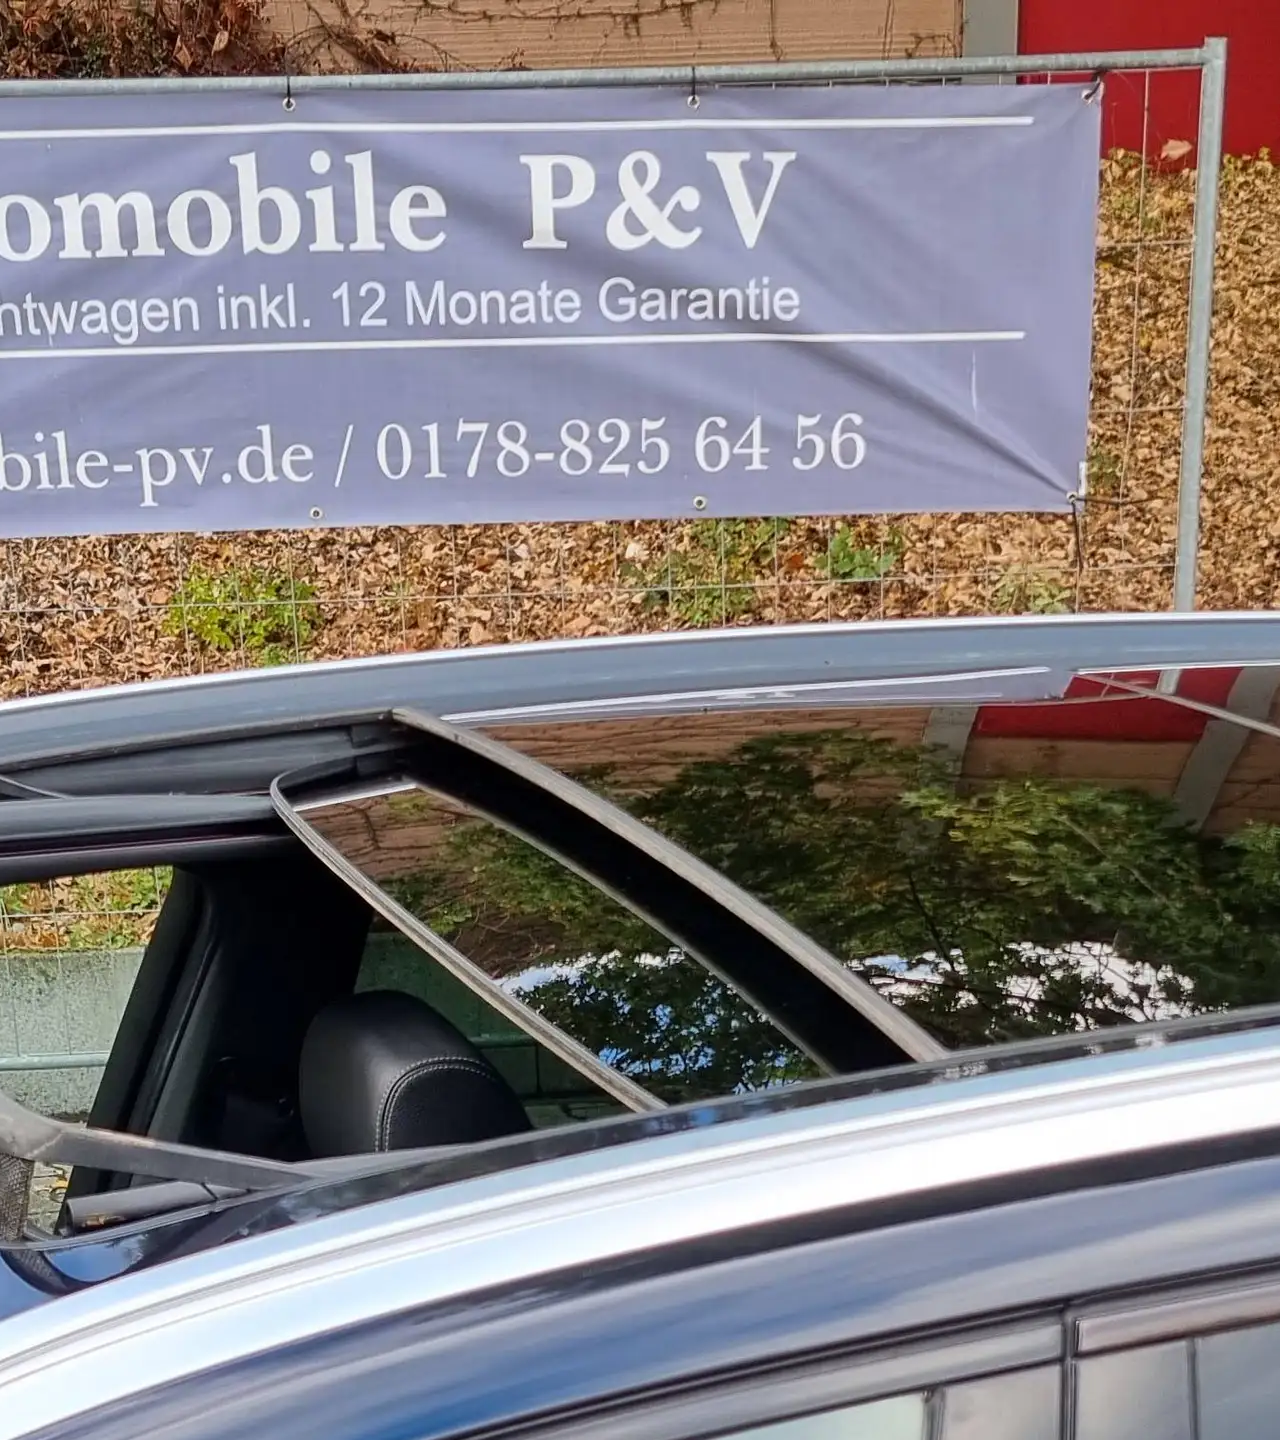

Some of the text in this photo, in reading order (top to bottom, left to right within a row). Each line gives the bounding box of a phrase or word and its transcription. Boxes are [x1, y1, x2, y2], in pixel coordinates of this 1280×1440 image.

[521, 150, 797, 252] P&V
[216, 282, 311, 331] inkl.
[332, 281, 388, 328] 12
[405, 279, 583, 327] Monate
[598, 275, 801, 323] Garantie
[333, 424, 355, 488] /
[376, 417, 671, 481] 0178-825
[694, 415, 771, 474] 64
[791, 412, 867, 472] 56
